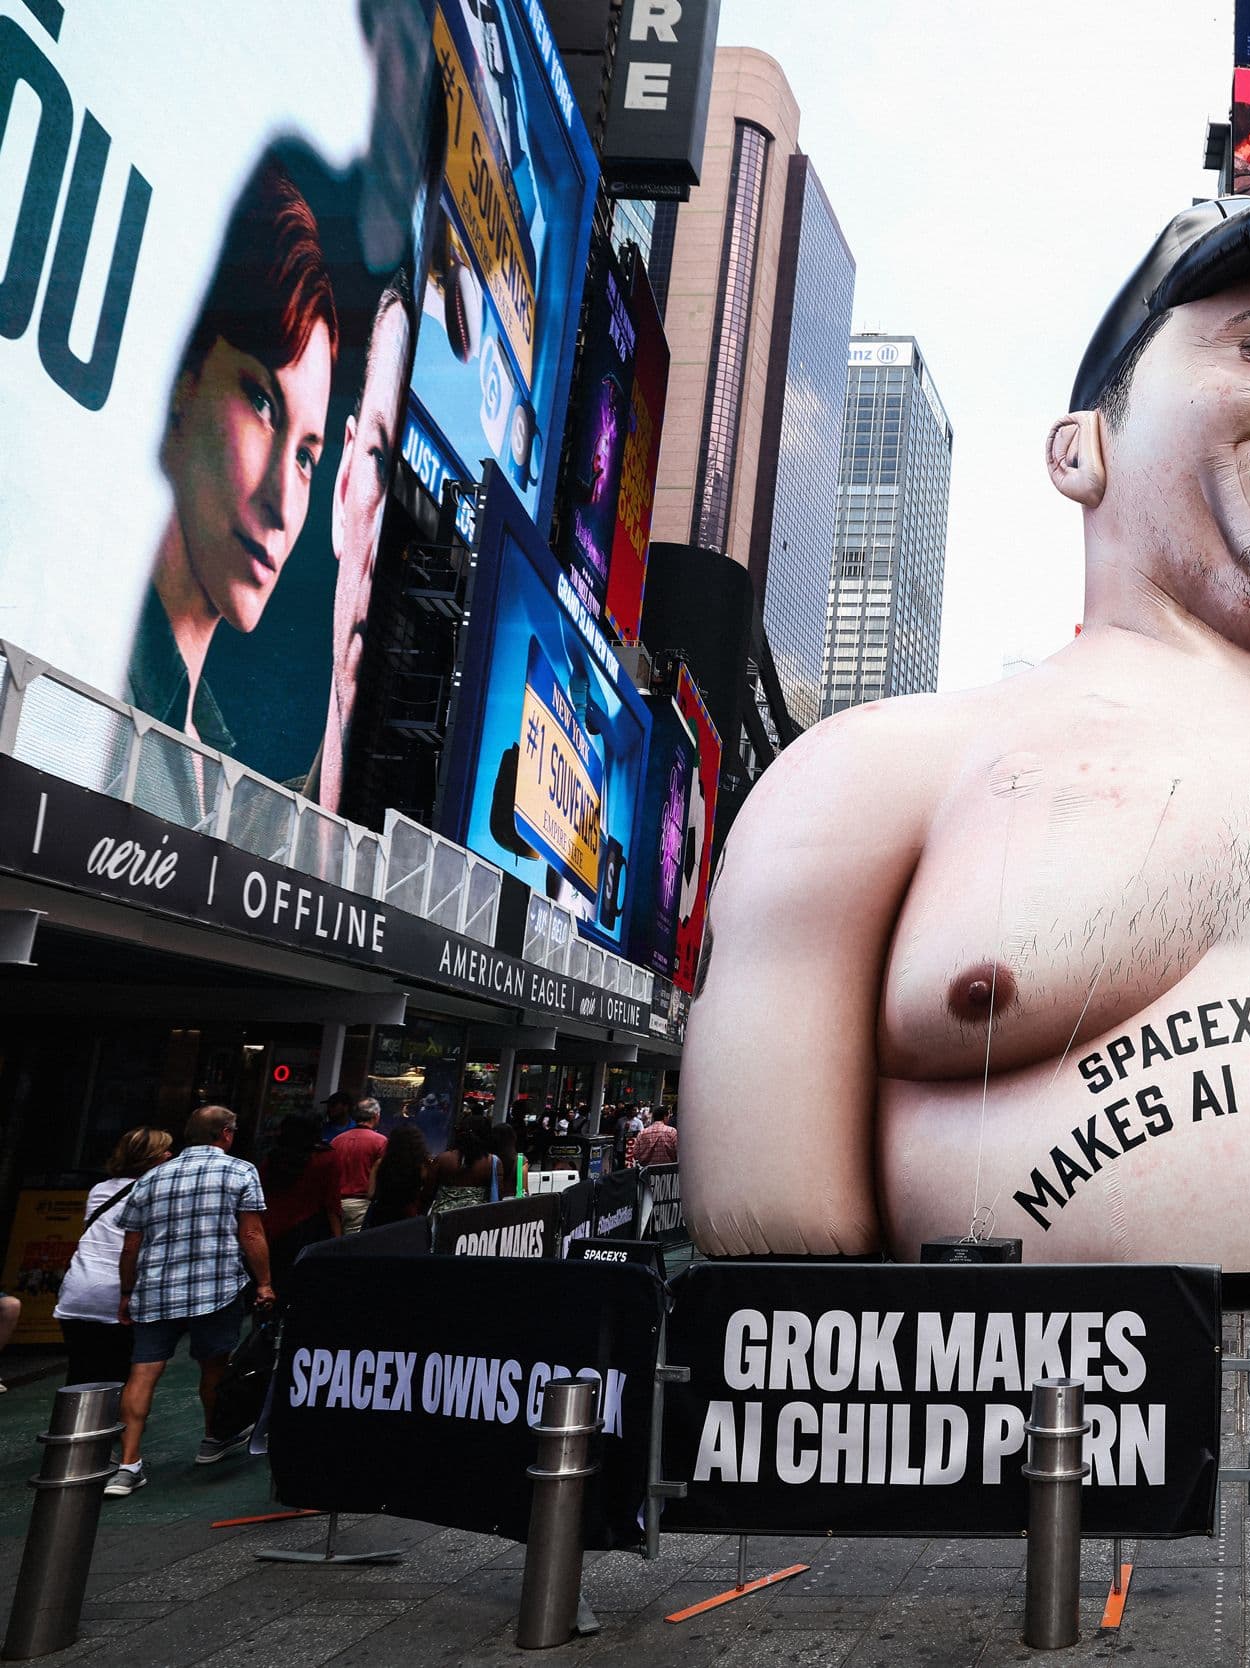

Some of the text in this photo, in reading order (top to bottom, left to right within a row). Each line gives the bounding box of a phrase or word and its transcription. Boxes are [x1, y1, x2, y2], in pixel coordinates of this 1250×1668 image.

[469, 132, 533, 344] SOUVENIRS
[402, 427, 440, 493] JUST
[557, 573, 580, 622] GRAND
[552, 682, 590, 758] NEW YORK
[526, 710, 600, 855] #1 SOUVENIRS
[87, 835, 179, 889] aerie
[243, 871, 386, 953] OFFLINE
[439, 940, 525, 998] AMERICAN
[531, 974, 566, 1009] EAGLE
[607, 998, 640, 1027] OFFLINE
[1012, 1085, 1174, 1232] MAKES
[1191, 1064, 1238, 1122] AI
[499, 1219, 545, 1258] MAKES
[584, 1249, 627, 1262] SPACEX'S
[290, 1347, 627, 1438] SPACEX OWNS GK
[723, 1309, 1147, 1393] GROK MAKES
[693, 1400, 1165, 1486] AI CHILD PRN
